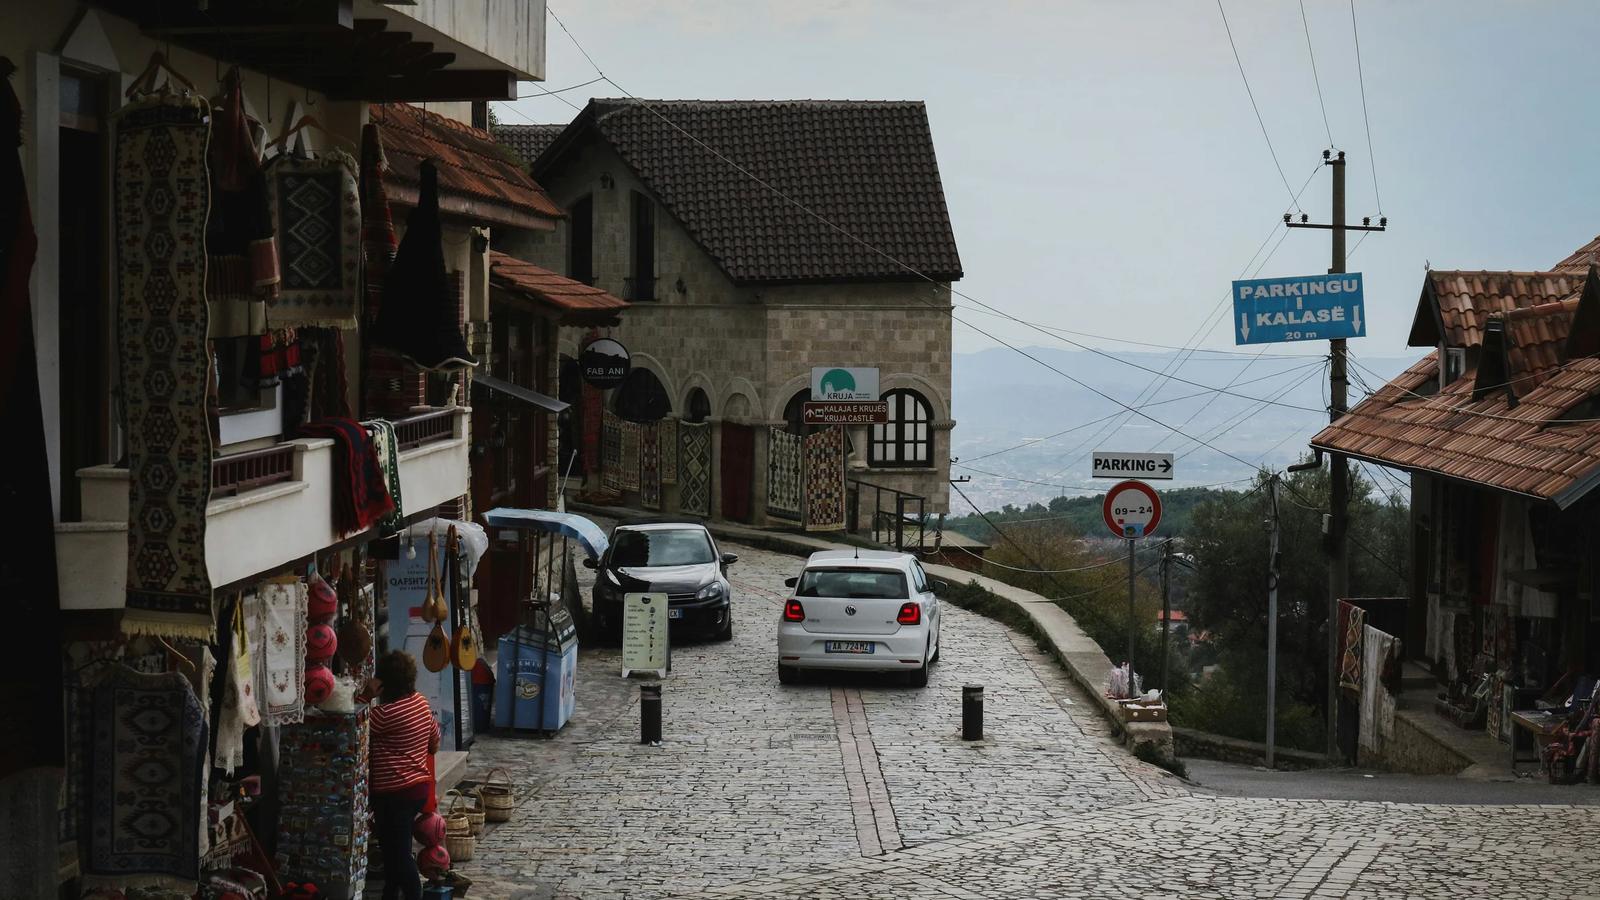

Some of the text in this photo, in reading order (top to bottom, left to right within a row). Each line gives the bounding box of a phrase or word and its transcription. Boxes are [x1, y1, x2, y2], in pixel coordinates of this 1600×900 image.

[1240, 279, 1358, 299] PARKINGU
[1256, 306, 1345, 326] KALASË
[1285, 331, 1301, 340] 20
[827, 392, 854, 400] KRUJA
[824, 405, 852, 413] KALAJA
[852, 405, 858, 413] E
[824, 414, 875, 422] KRUJA CASTLE
[1094, 458, 1156, 471] PARKING
